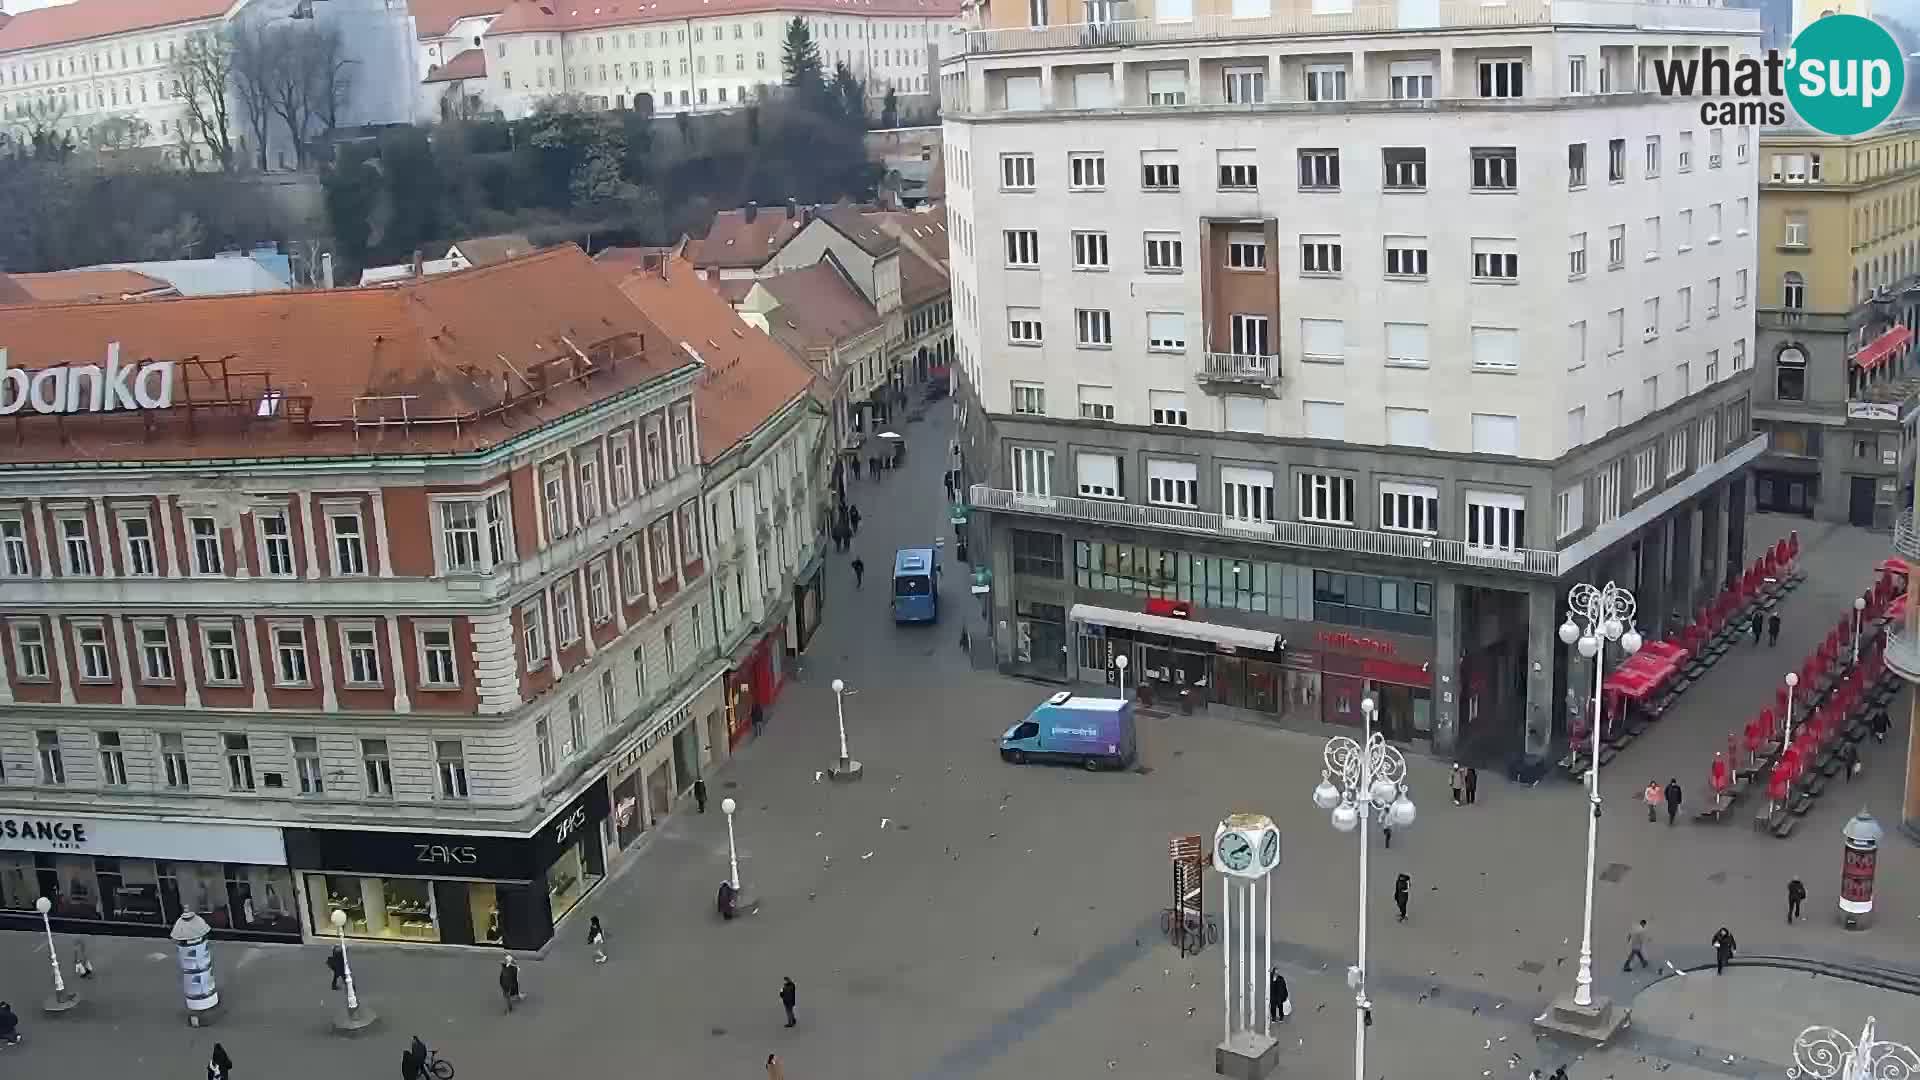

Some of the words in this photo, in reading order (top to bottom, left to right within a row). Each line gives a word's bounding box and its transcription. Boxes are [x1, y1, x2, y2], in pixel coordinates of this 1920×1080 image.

[0, 341, 176, 414] banka
[0, 820, 87, 841] SANGE
[556, 805, 585, 843] ZAKS
[414, 845, 477, 864] ZAKS
